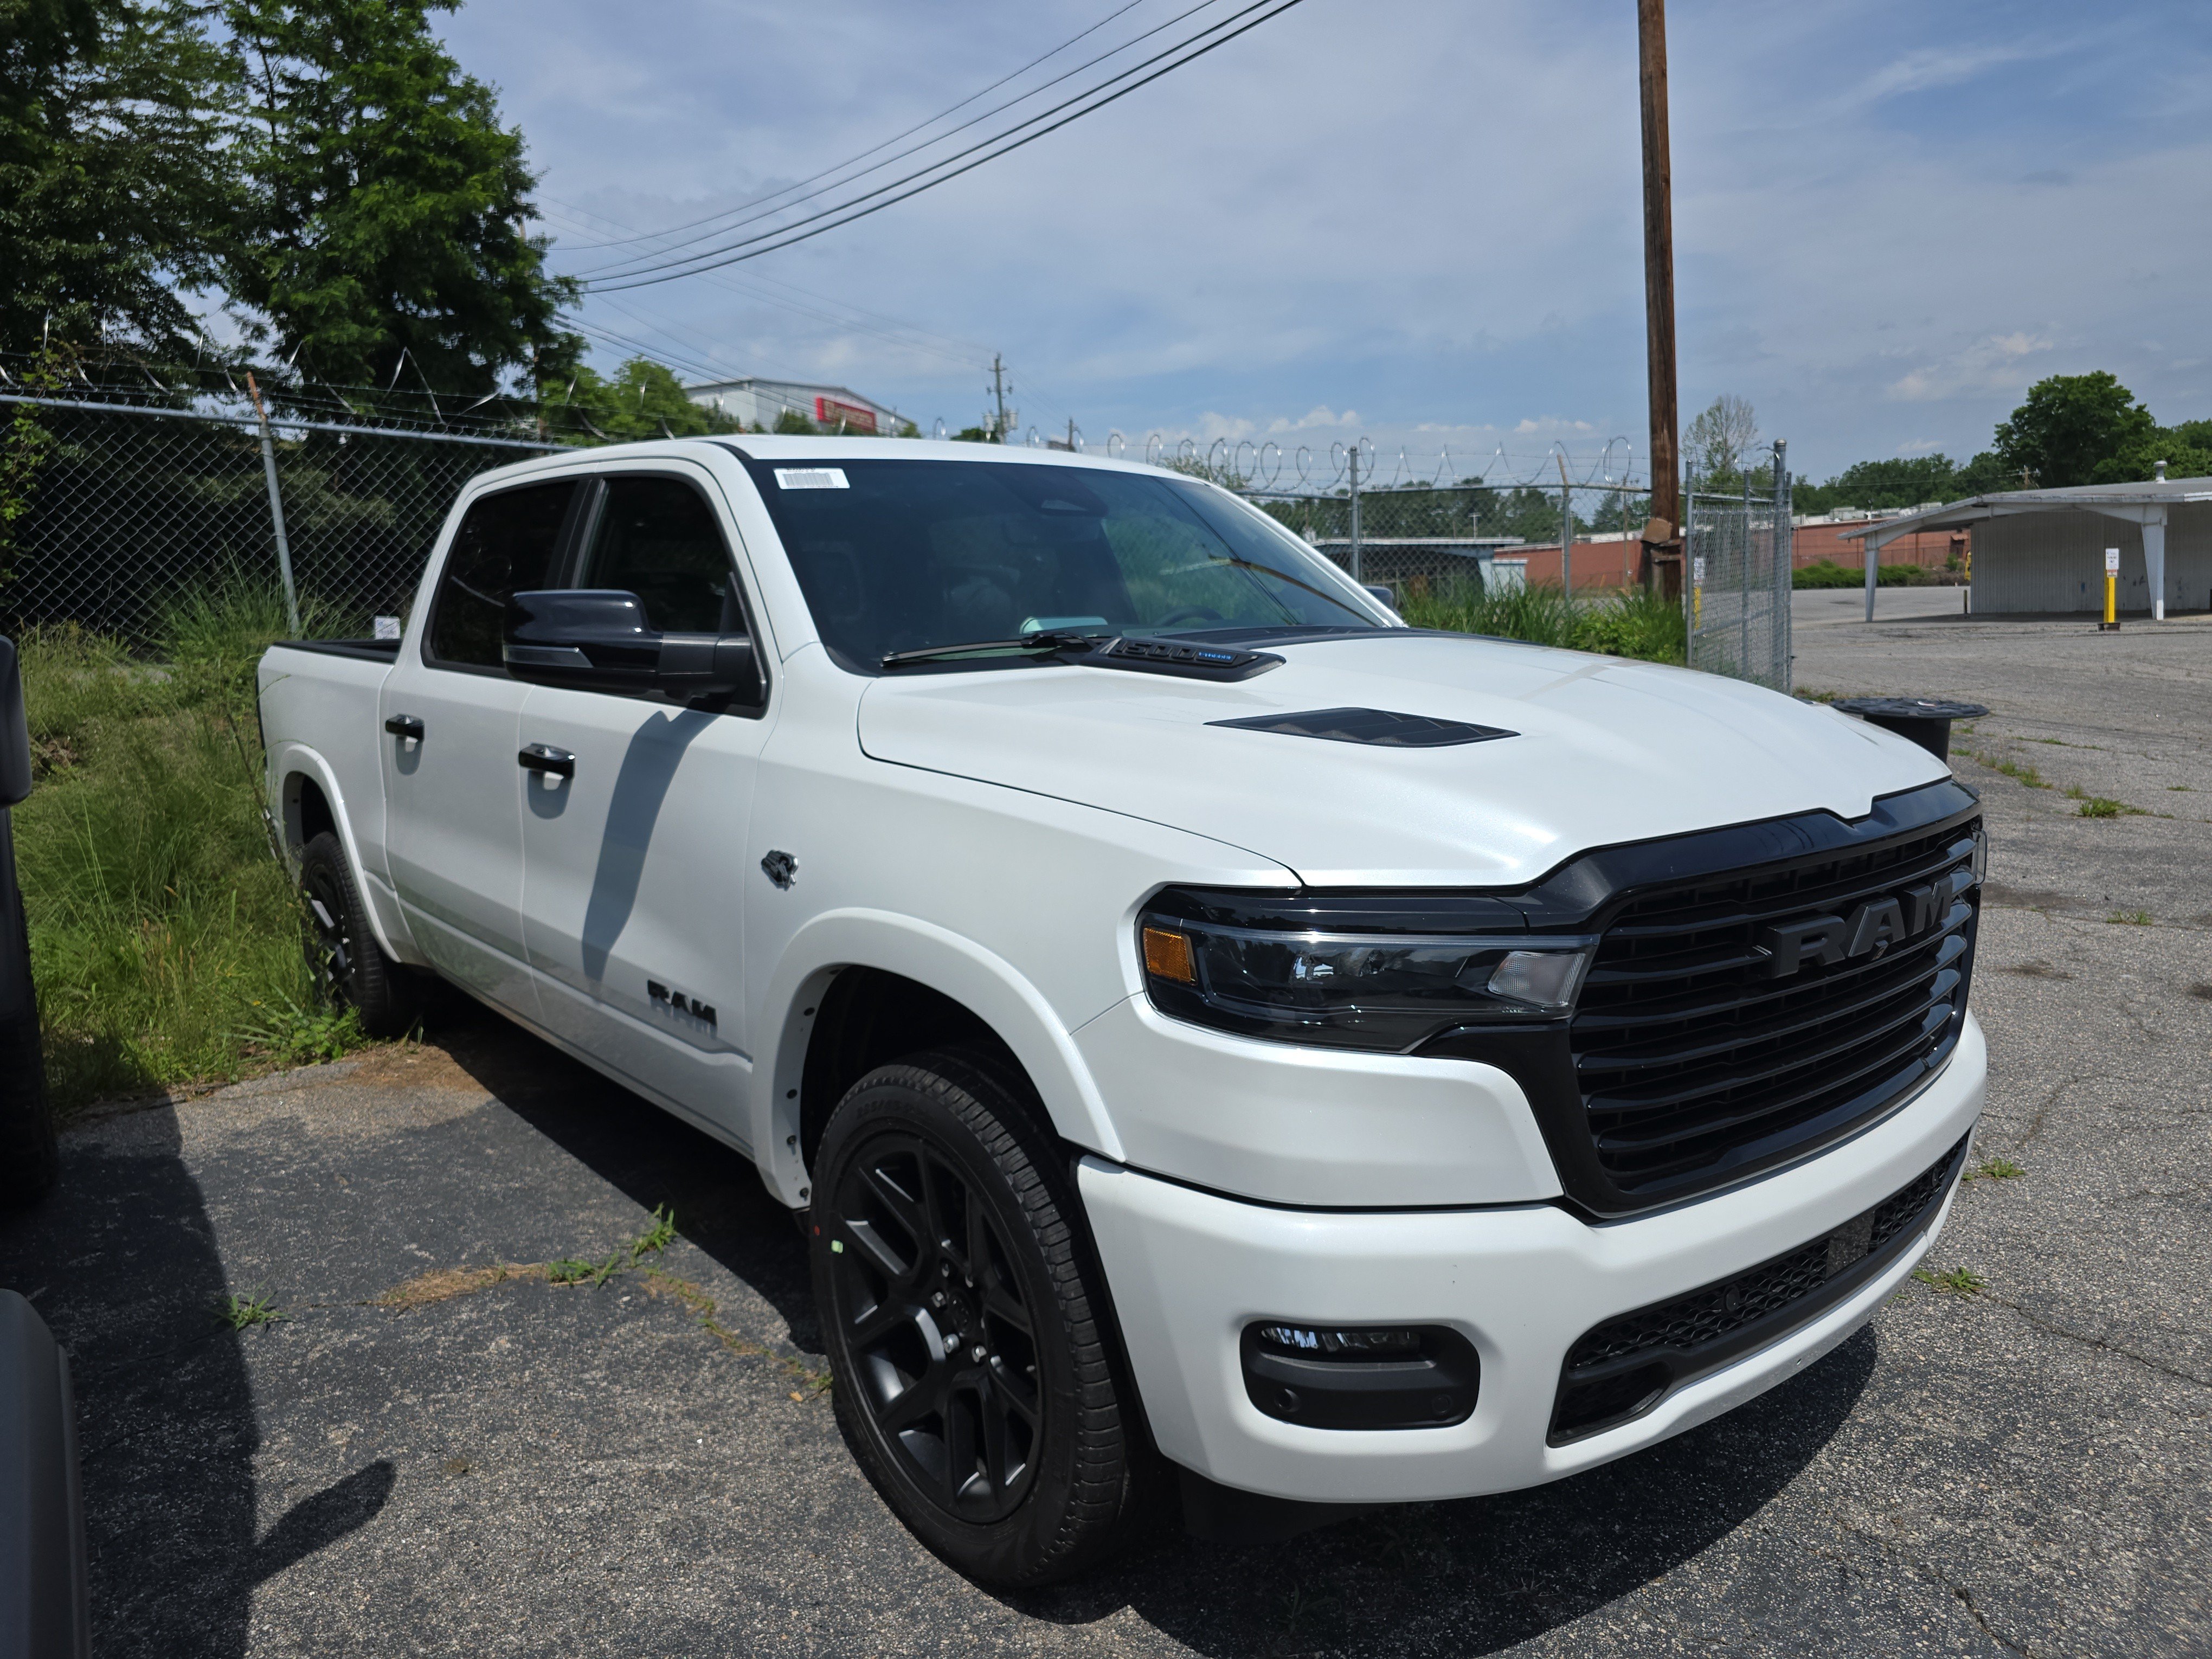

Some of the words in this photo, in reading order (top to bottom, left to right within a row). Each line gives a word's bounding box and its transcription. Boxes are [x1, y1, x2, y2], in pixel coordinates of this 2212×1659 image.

[1116, 639, 1198, 660] 1500
[1768, 874, 1953, 978] RAM
[647, 979, 718, 1026] RAM
